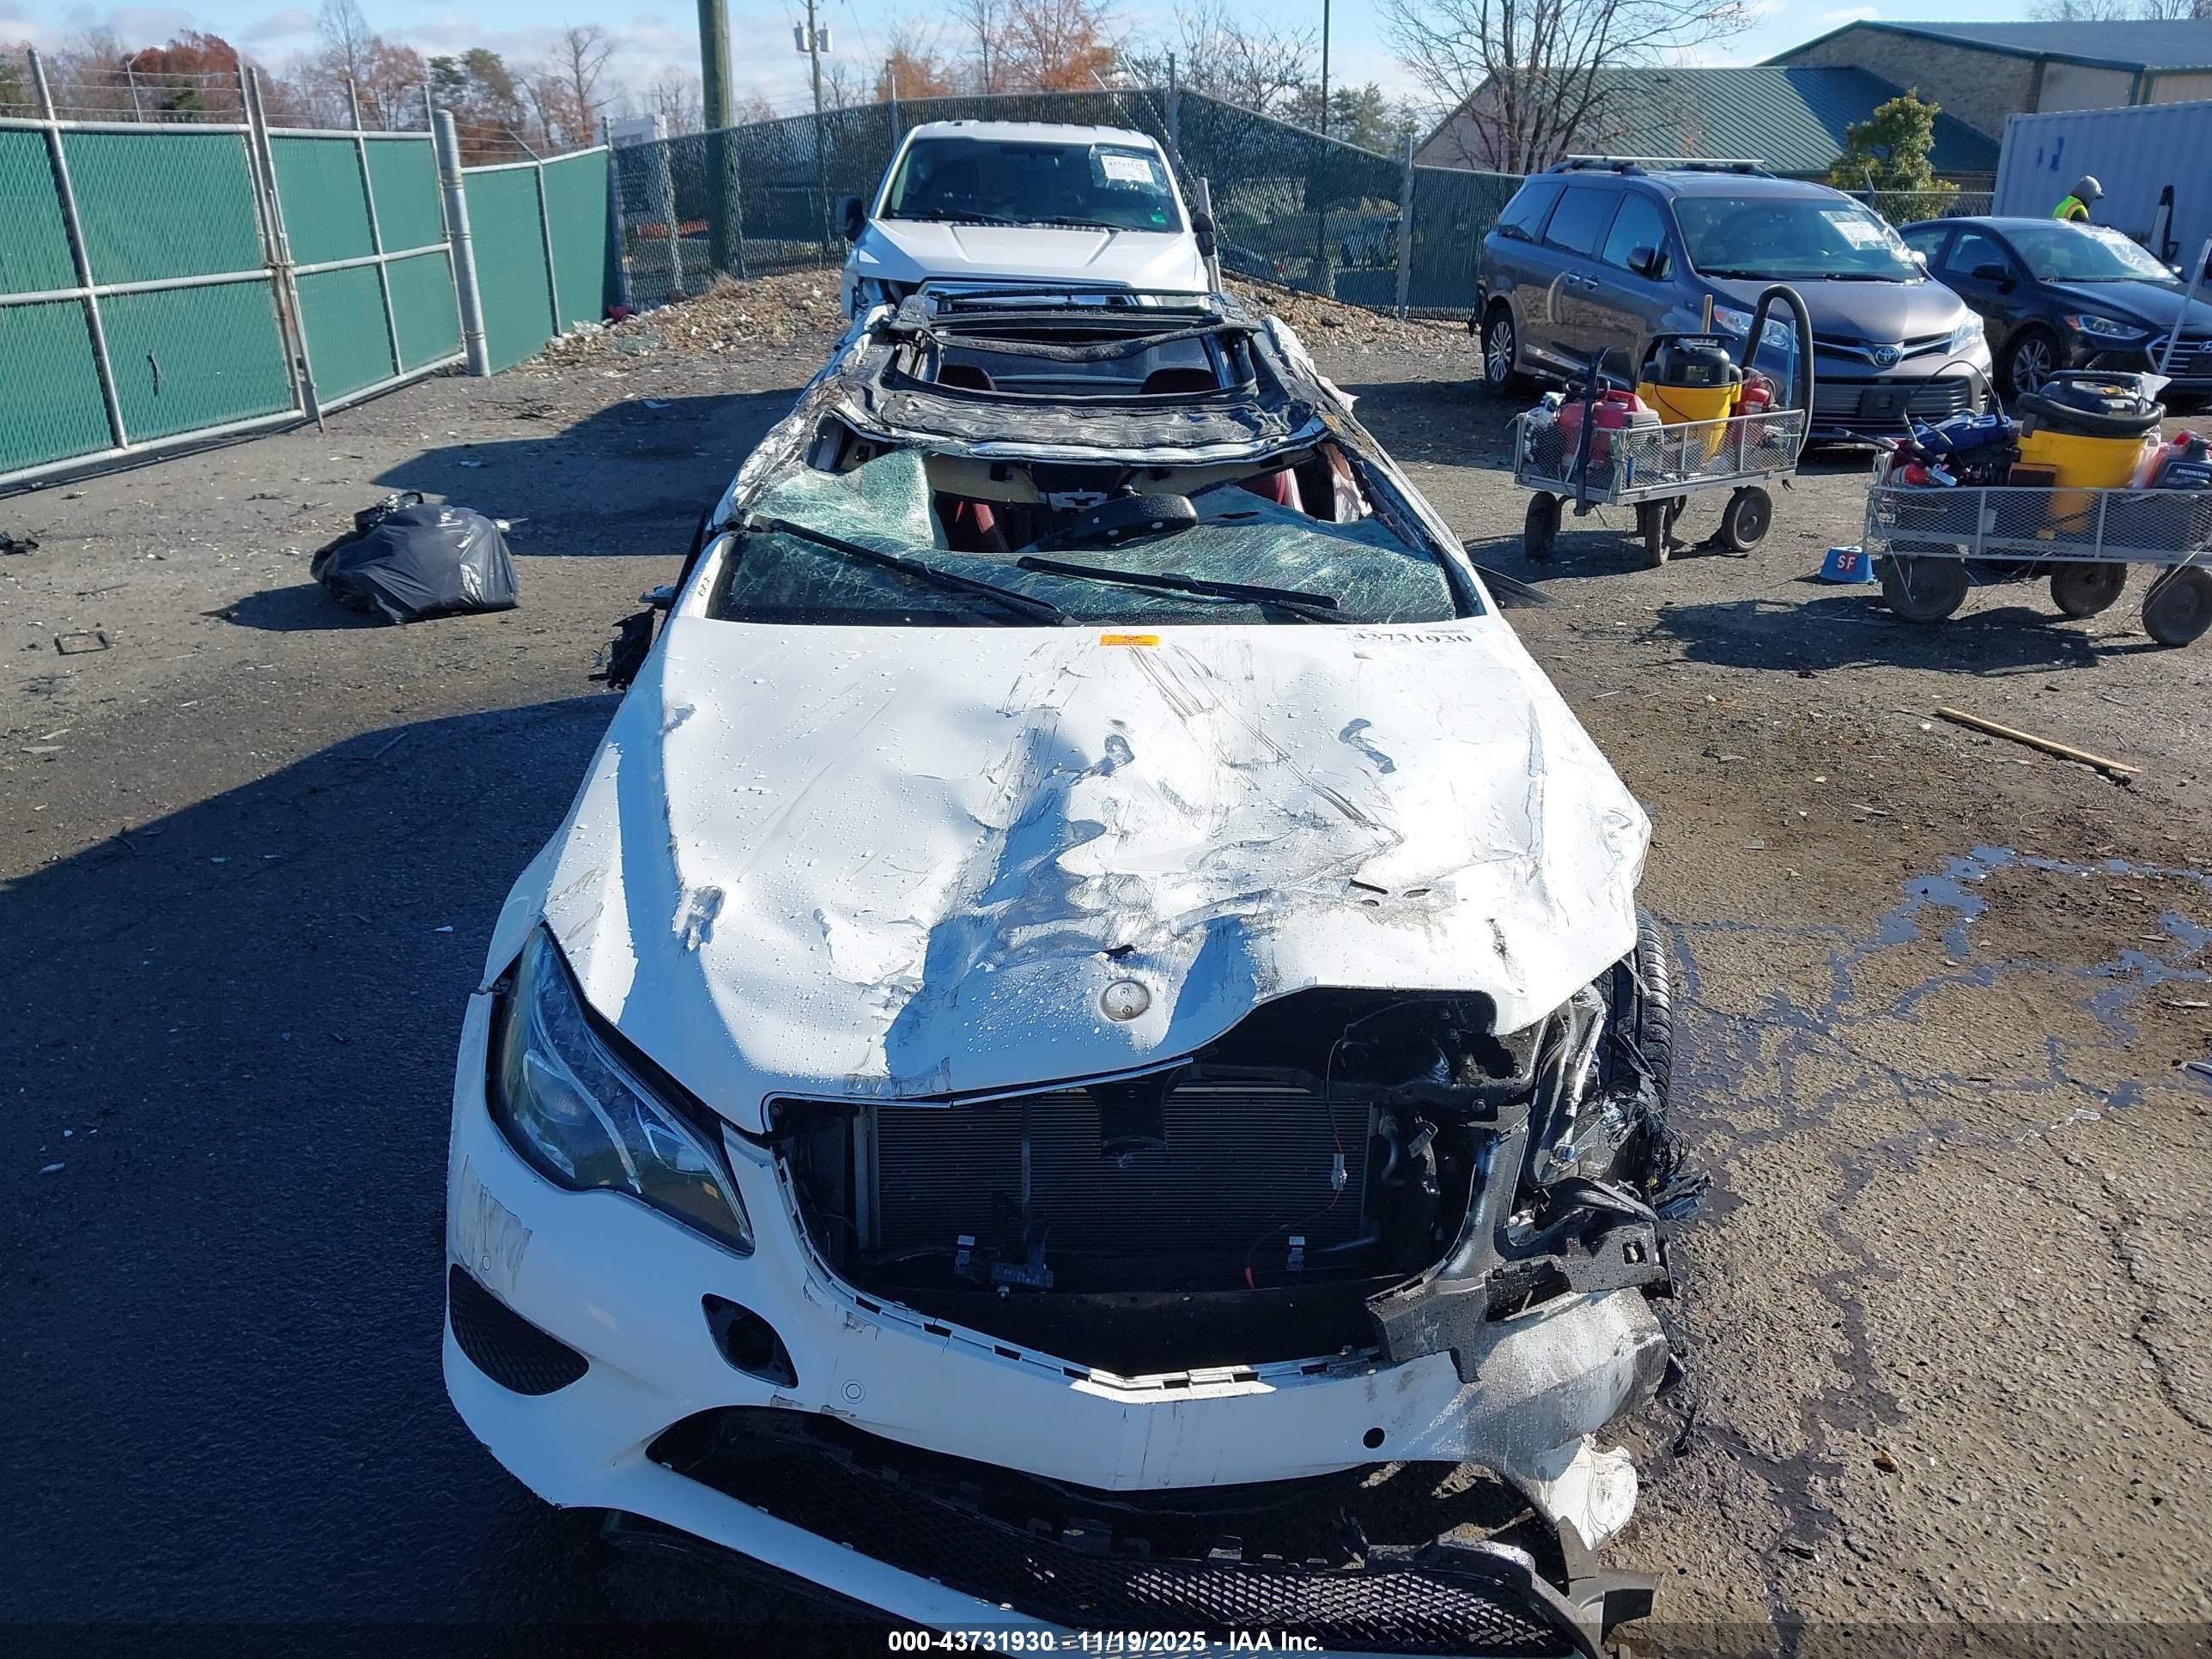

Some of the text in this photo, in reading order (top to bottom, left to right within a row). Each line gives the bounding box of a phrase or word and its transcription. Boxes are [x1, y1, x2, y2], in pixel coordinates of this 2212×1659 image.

[2176, 468, 2211, 478] HONDA
[1837, 555, 1856, 570] SF
[1352, 633, 1473, 644] 43731930
